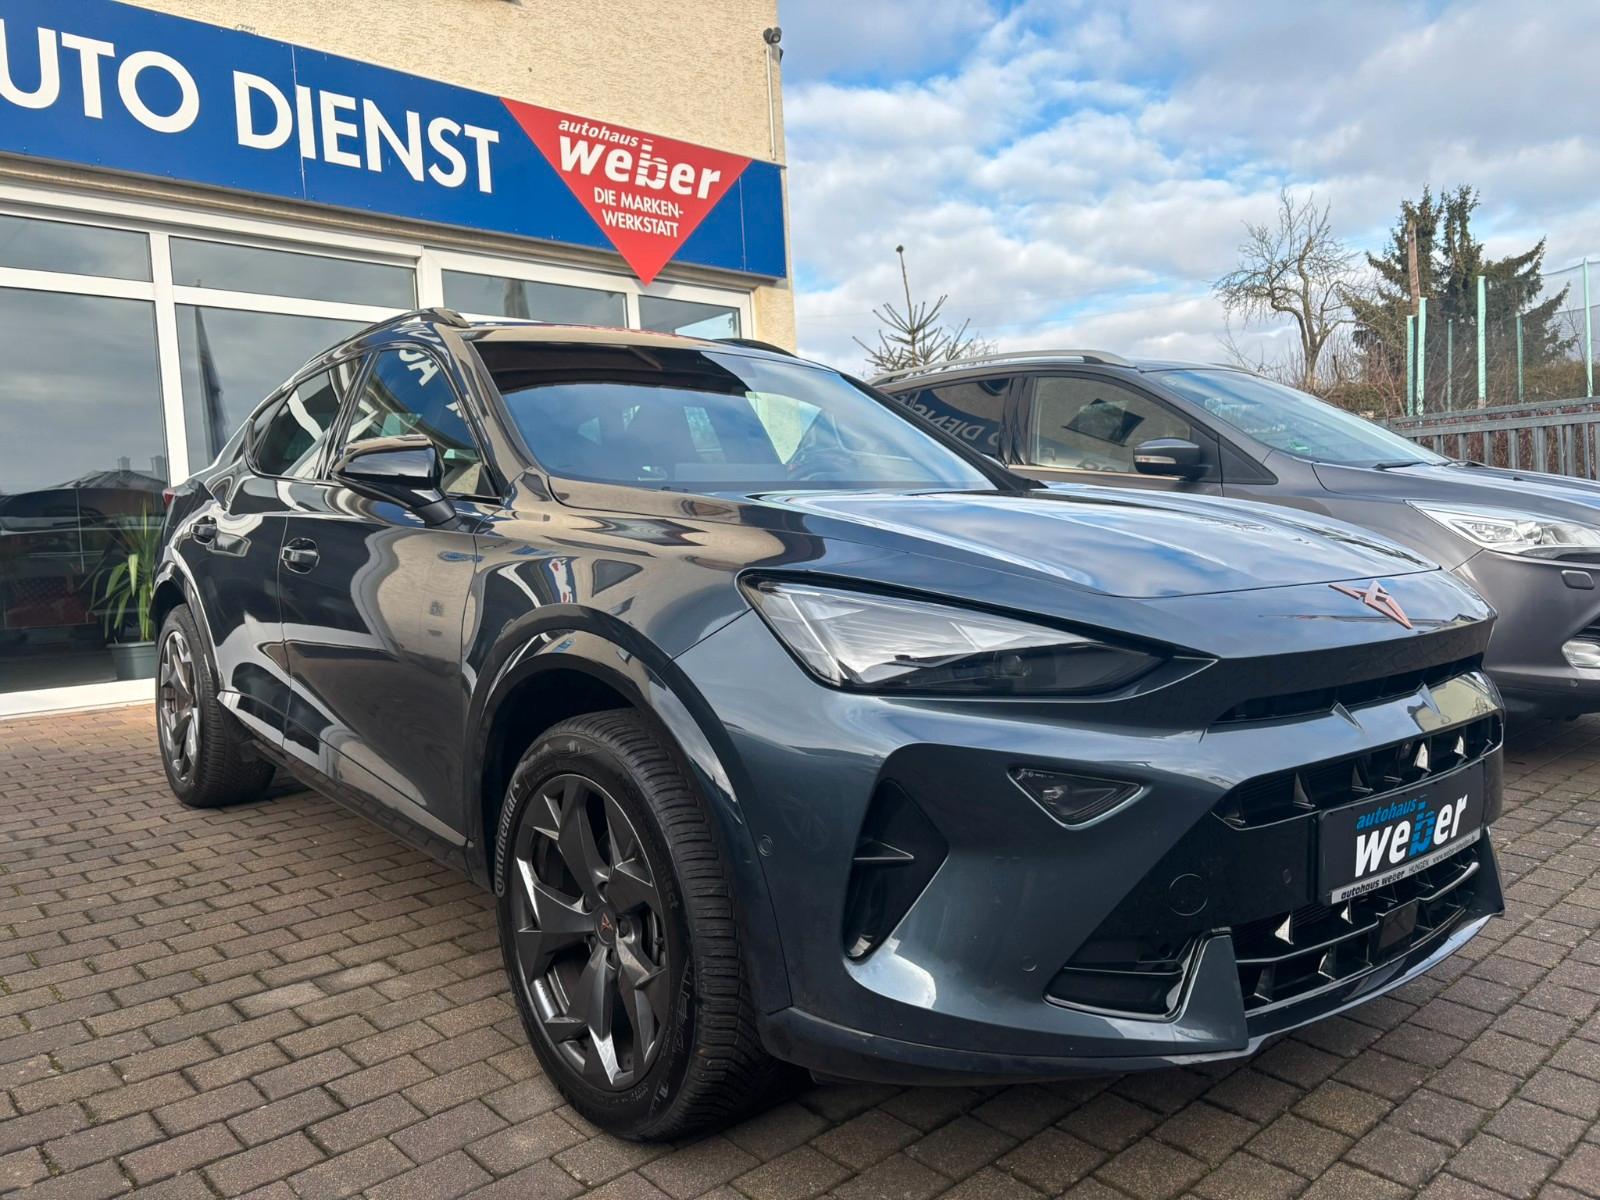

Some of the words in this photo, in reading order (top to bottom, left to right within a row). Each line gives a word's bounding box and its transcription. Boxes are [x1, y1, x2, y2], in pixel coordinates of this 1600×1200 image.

[233, 70, 500, 193] DIENST
[558, 119, 639, 147] autohaus
[559, 135, 722, 200] weber
[594, 186, 617, 207] DIE
[620, 191, 684, 218] MARKEN-
[602, 208, 680, 238] WERKSTATT
[1356, 798, 1417, 830] autohaus
[1355, 794, 1468, 878] weber
[1341, 880, 1380, 899] autohaus
